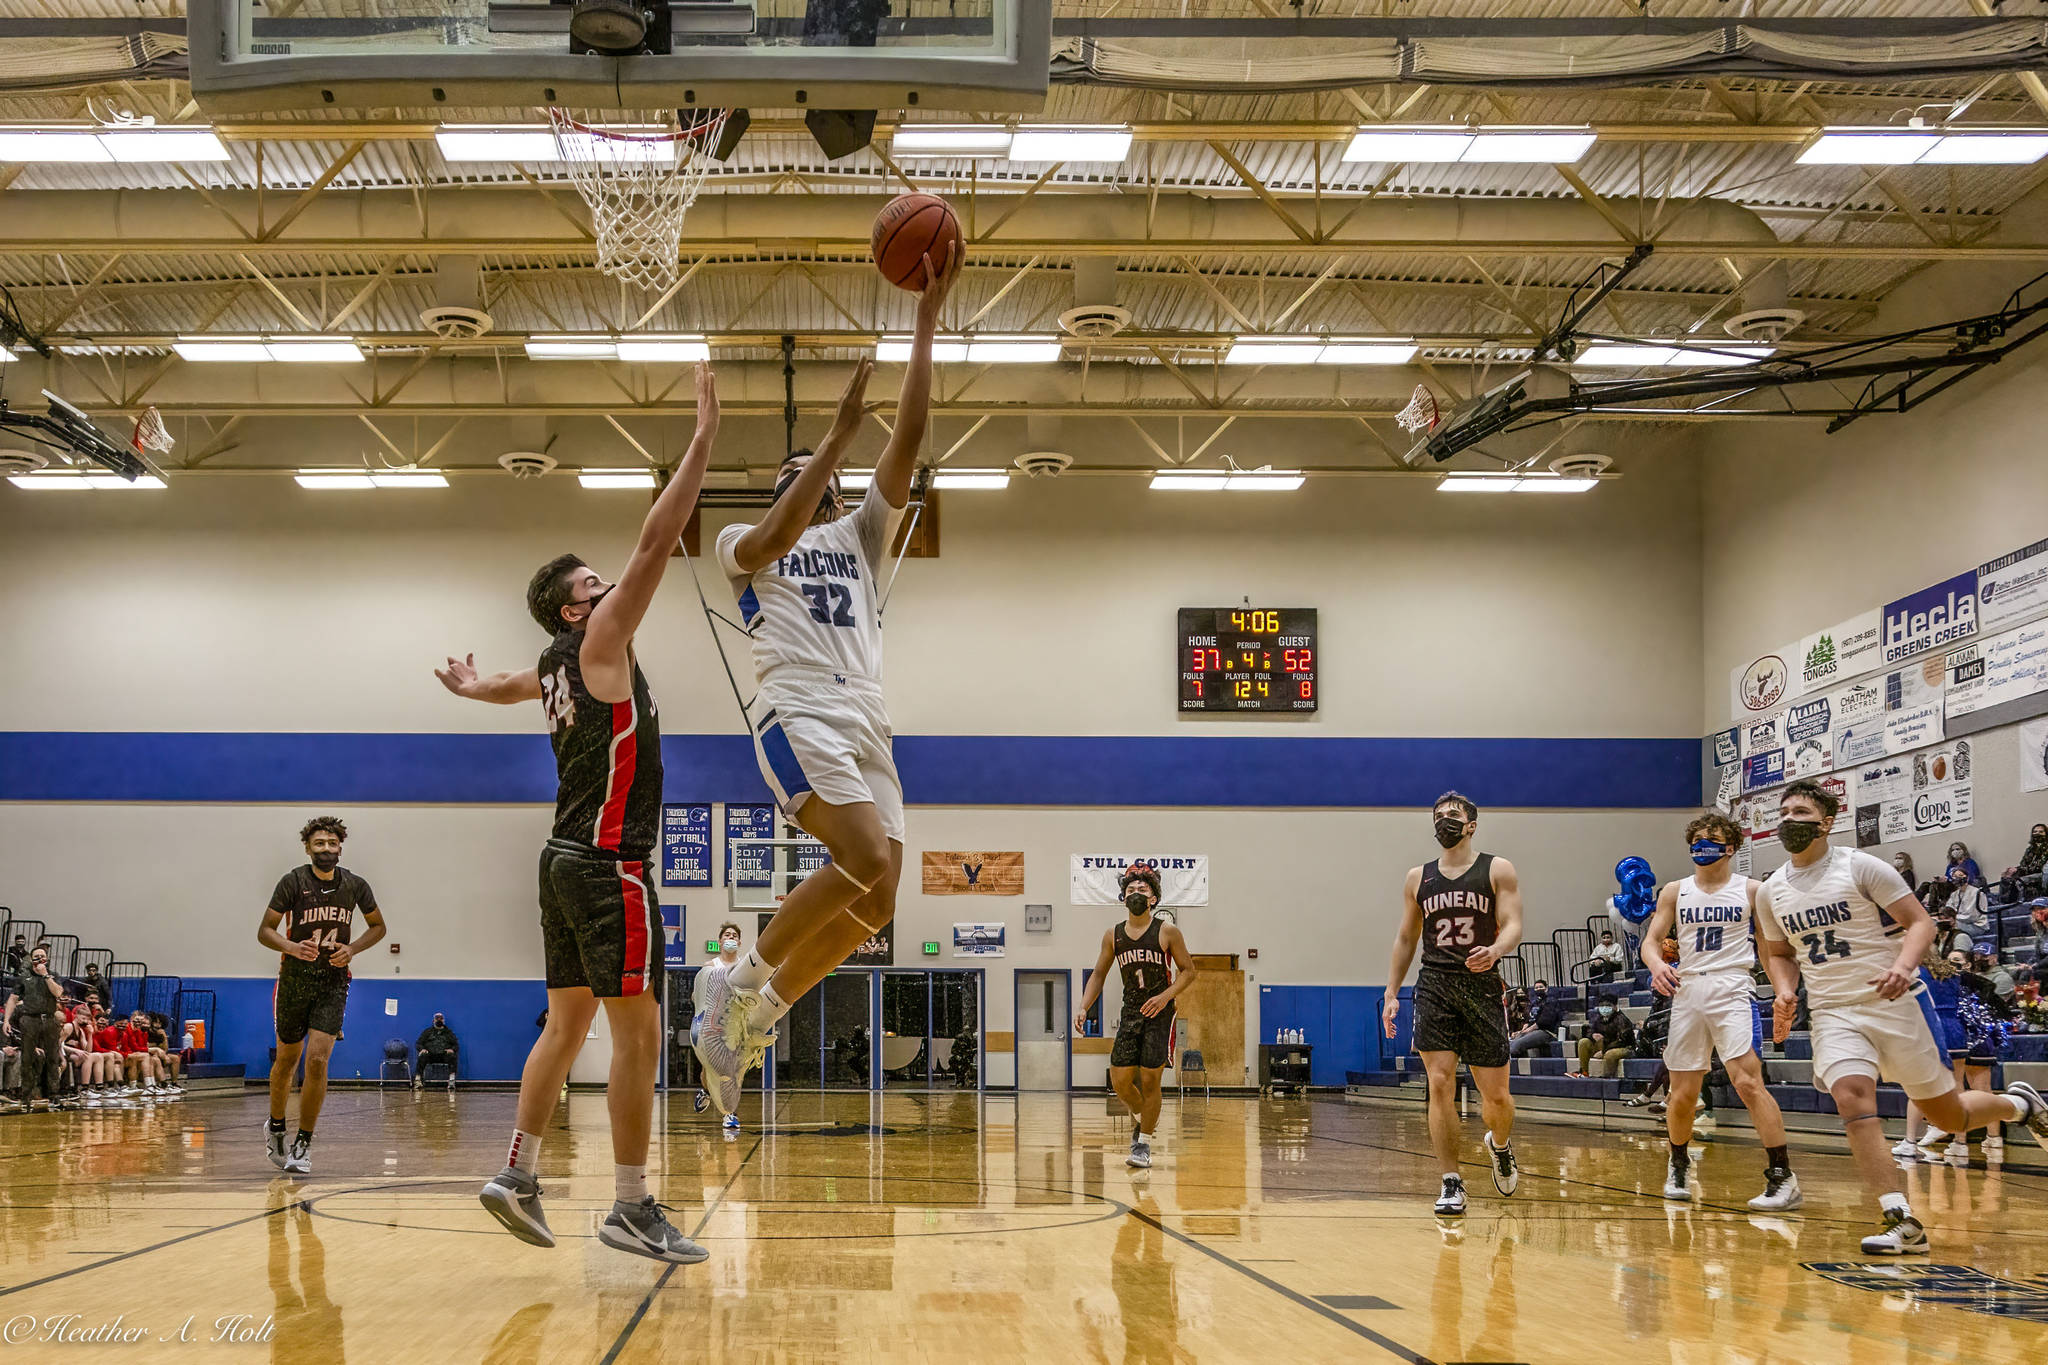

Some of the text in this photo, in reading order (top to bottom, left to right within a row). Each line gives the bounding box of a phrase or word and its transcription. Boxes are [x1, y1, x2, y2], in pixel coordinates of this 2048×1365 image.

[778, 549, 859, 580] FALCONS
[801, 582, 856, 628] 32
[1231, 611, 1280, 632] 4:06
[1887, 592, 1975, 645] Hecla
[1188, 636, 1217, 646] HOME
[1278, 636, 1310, 646] GUEST
[1887, 620, 1974, 661] GREENS CREEK
[1193, 649, 1221, 671] 37
[1243, 652, 1254, 668] 4
[1284, 649, 1312, 671] 52
[1947, 648, 1975, 668] ALASKAN
[833, 674, 846, 685] TM
[1803, 660, 1837, 682] TONGASS
[1960, 662, 1982, 681] DAMES
[1192, 680, 1203, 696] 7
[1234, 681, 1251, 697] 12
[1258, 682, 1268, 696] 4
[1301, 681, 1311, 697] 8
[1840, 688, 1877, 707] CHATHAM
[1788, 698, 1828, 729] ALASKA
[1841, 698, 1877, 714] ELECTRIC
[1742, 711, 1784, 730] GOOD LUCK
[1747, 742, 1780, 756] FALCONS
[666, 808, 688, 817] THUNDER
[729, 808, 750, 817] THUNDER
[1914, 794, 1951, 824] Coppa
[666, 834, 708, 846] SOFTBALL
[671, 847, 703, 855] 2017
[736, 848, 766, 857] 2017
[674, 858, 699, 869] STATE
[737, 858, 762, 869] STATE
[799, 858, 824, 868] STATE
[1083, 858, 1196, 869] FULL COURT
[666, 869, 708, 880] CHAMPIONS
[1422, 891, 1489, 919] JUNEAU
[300, 906, 353, 925] JUNEAU
[1680, 906, 1743, 925] FALCONS
[1781, 900, 1852, 935] FALCONS
[312, 928, 338, 950] 14
[1436, 916, 1474, 946] 23
[1695, 926, 1724, 952] 10
[1801, 929, 1851, 965] 24
[1117, 949, 1162, 968] JUNEAU
[1135, 969, 1144, 989] 1
